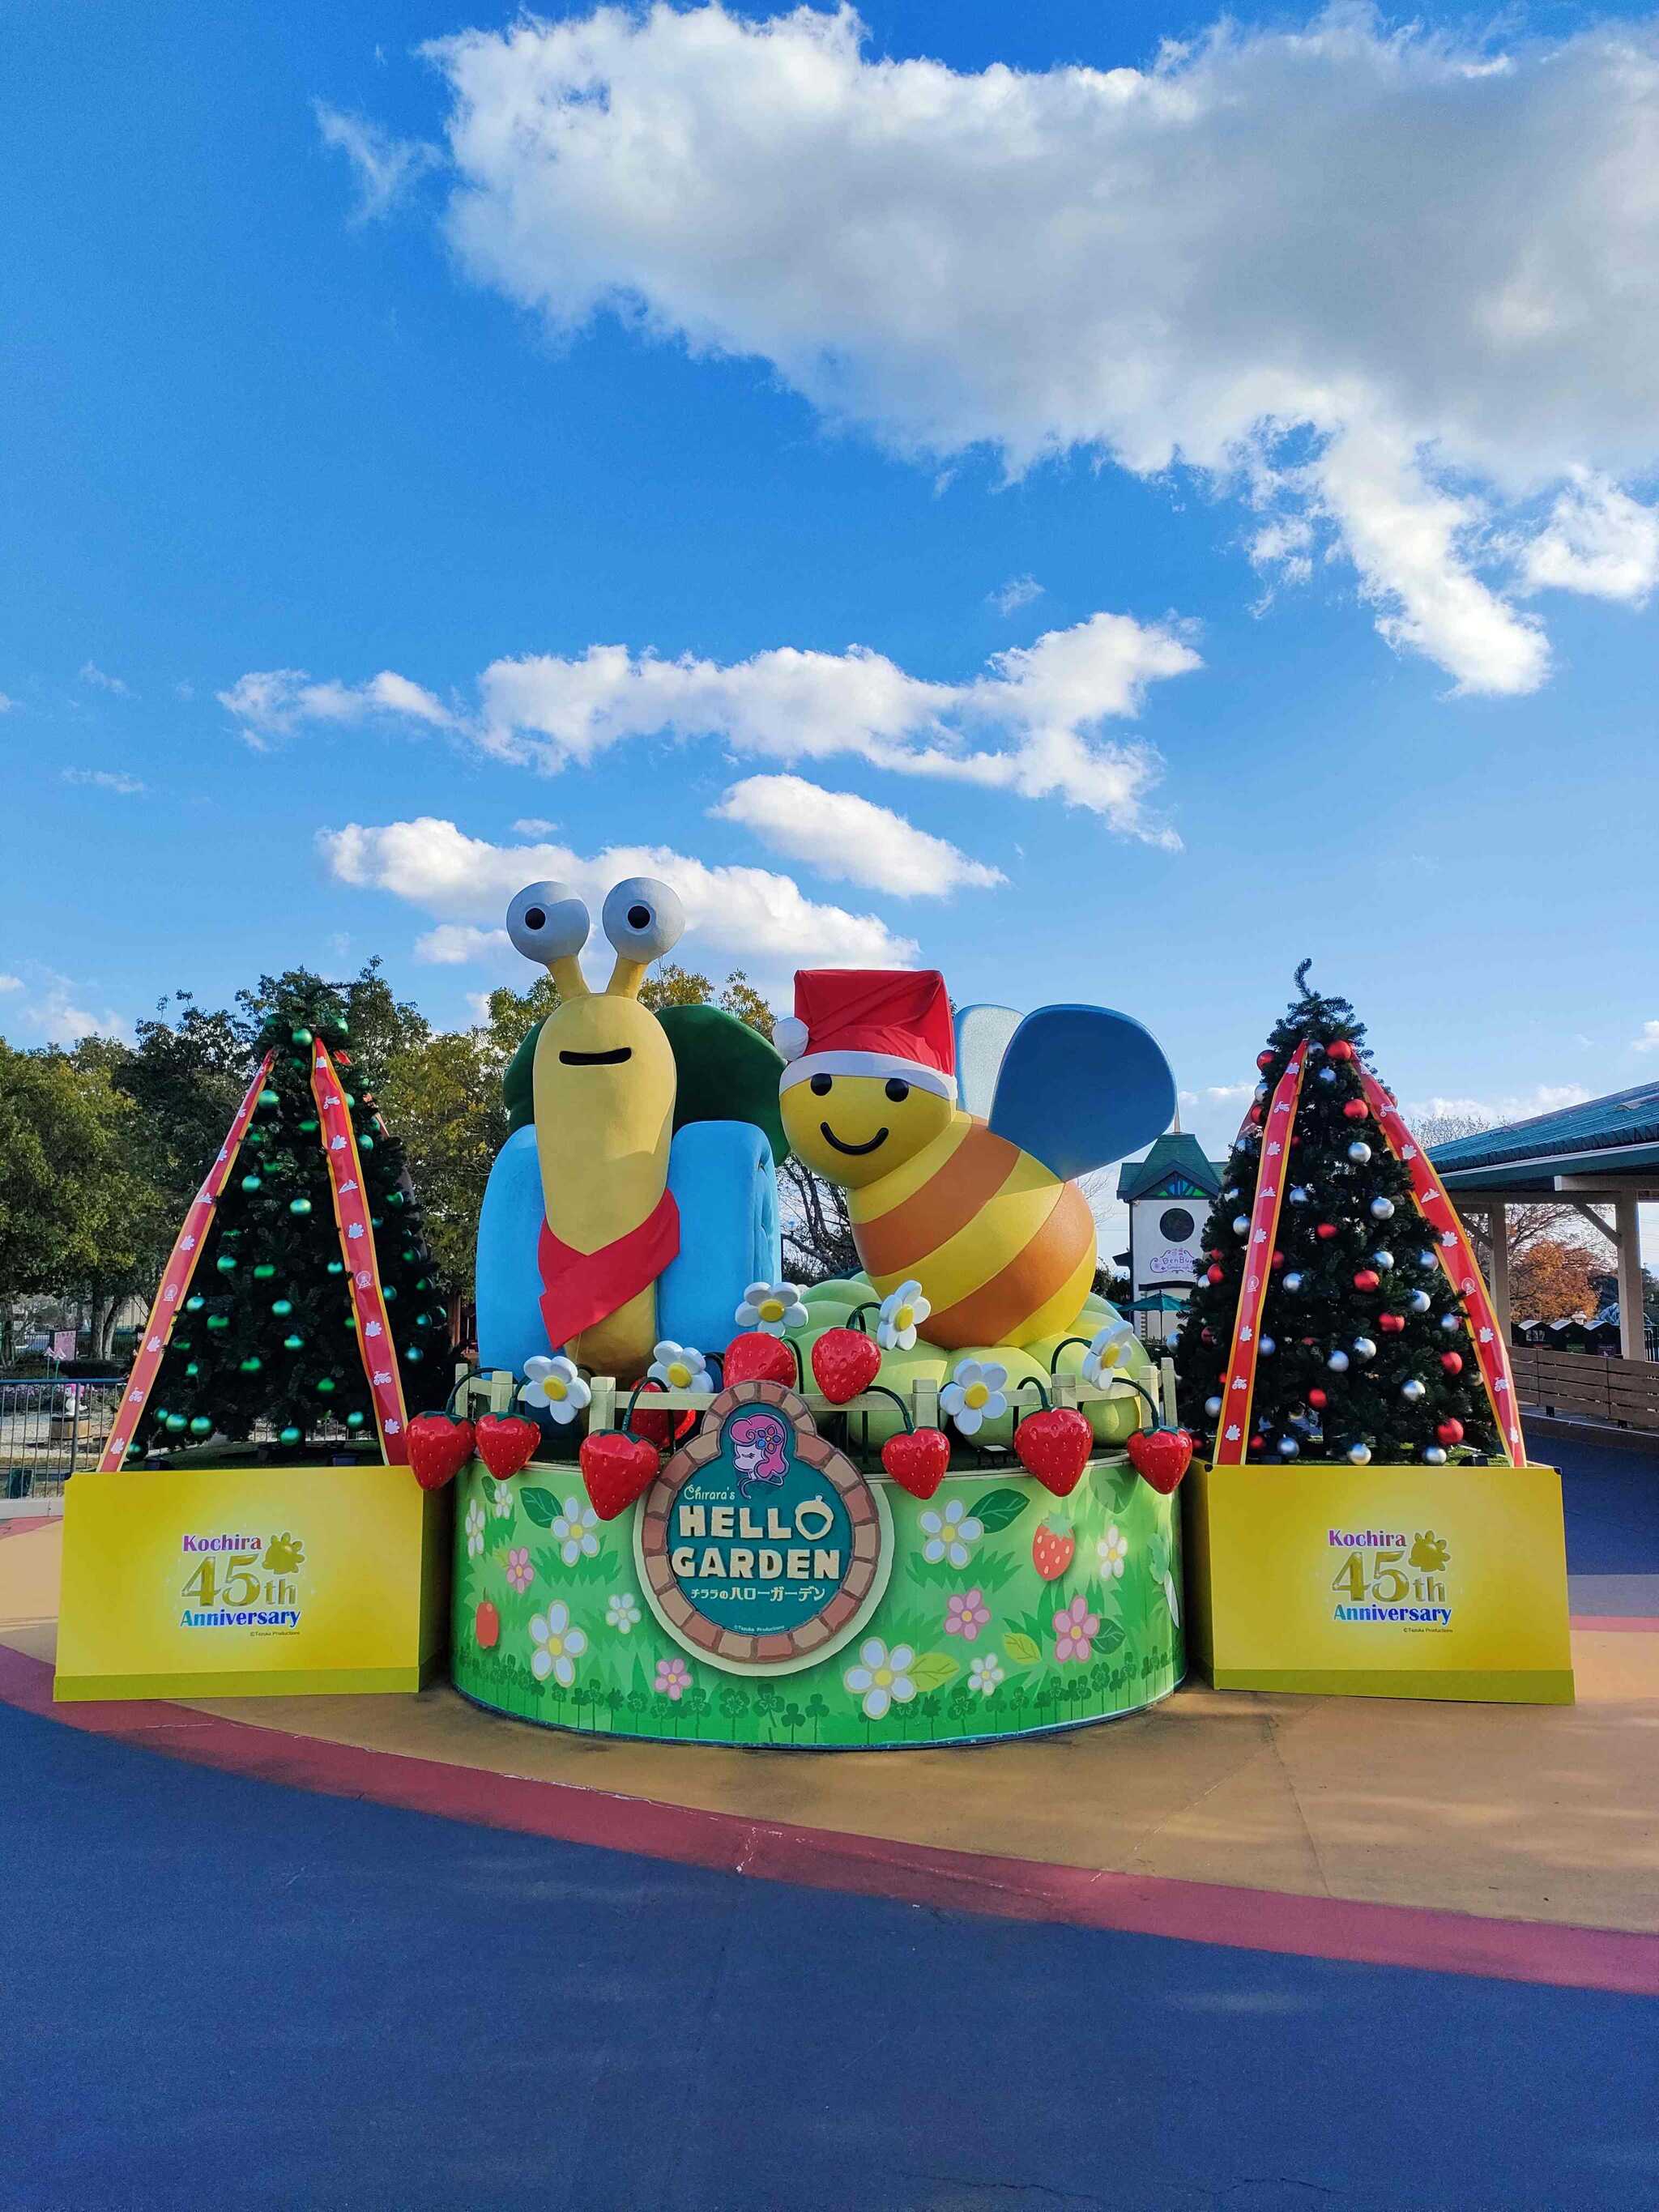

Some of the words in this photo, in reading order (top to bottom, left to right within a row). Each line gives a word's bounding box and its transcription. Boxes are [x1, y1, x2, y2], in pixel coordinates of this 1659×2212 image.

[684, 1484, 736, 1500] Chirara's
[679, 1494, 834, 1541] HELLO
[183, 1534, 262, 1552] Kochira
[1328, 1529, 1406, 1547] Kochira
[672, 1546, 840, 1579] GARDEN
[181, 1554, 296, 1607] 45th
[1332, 1550, 1446, 1602] 45th
[690, 1585, 825, 1602] チララのハローガーデン
[181, 1609, 301, 1627] Anniversary
[1334, 1604, 1452, 1625] Anniversary
